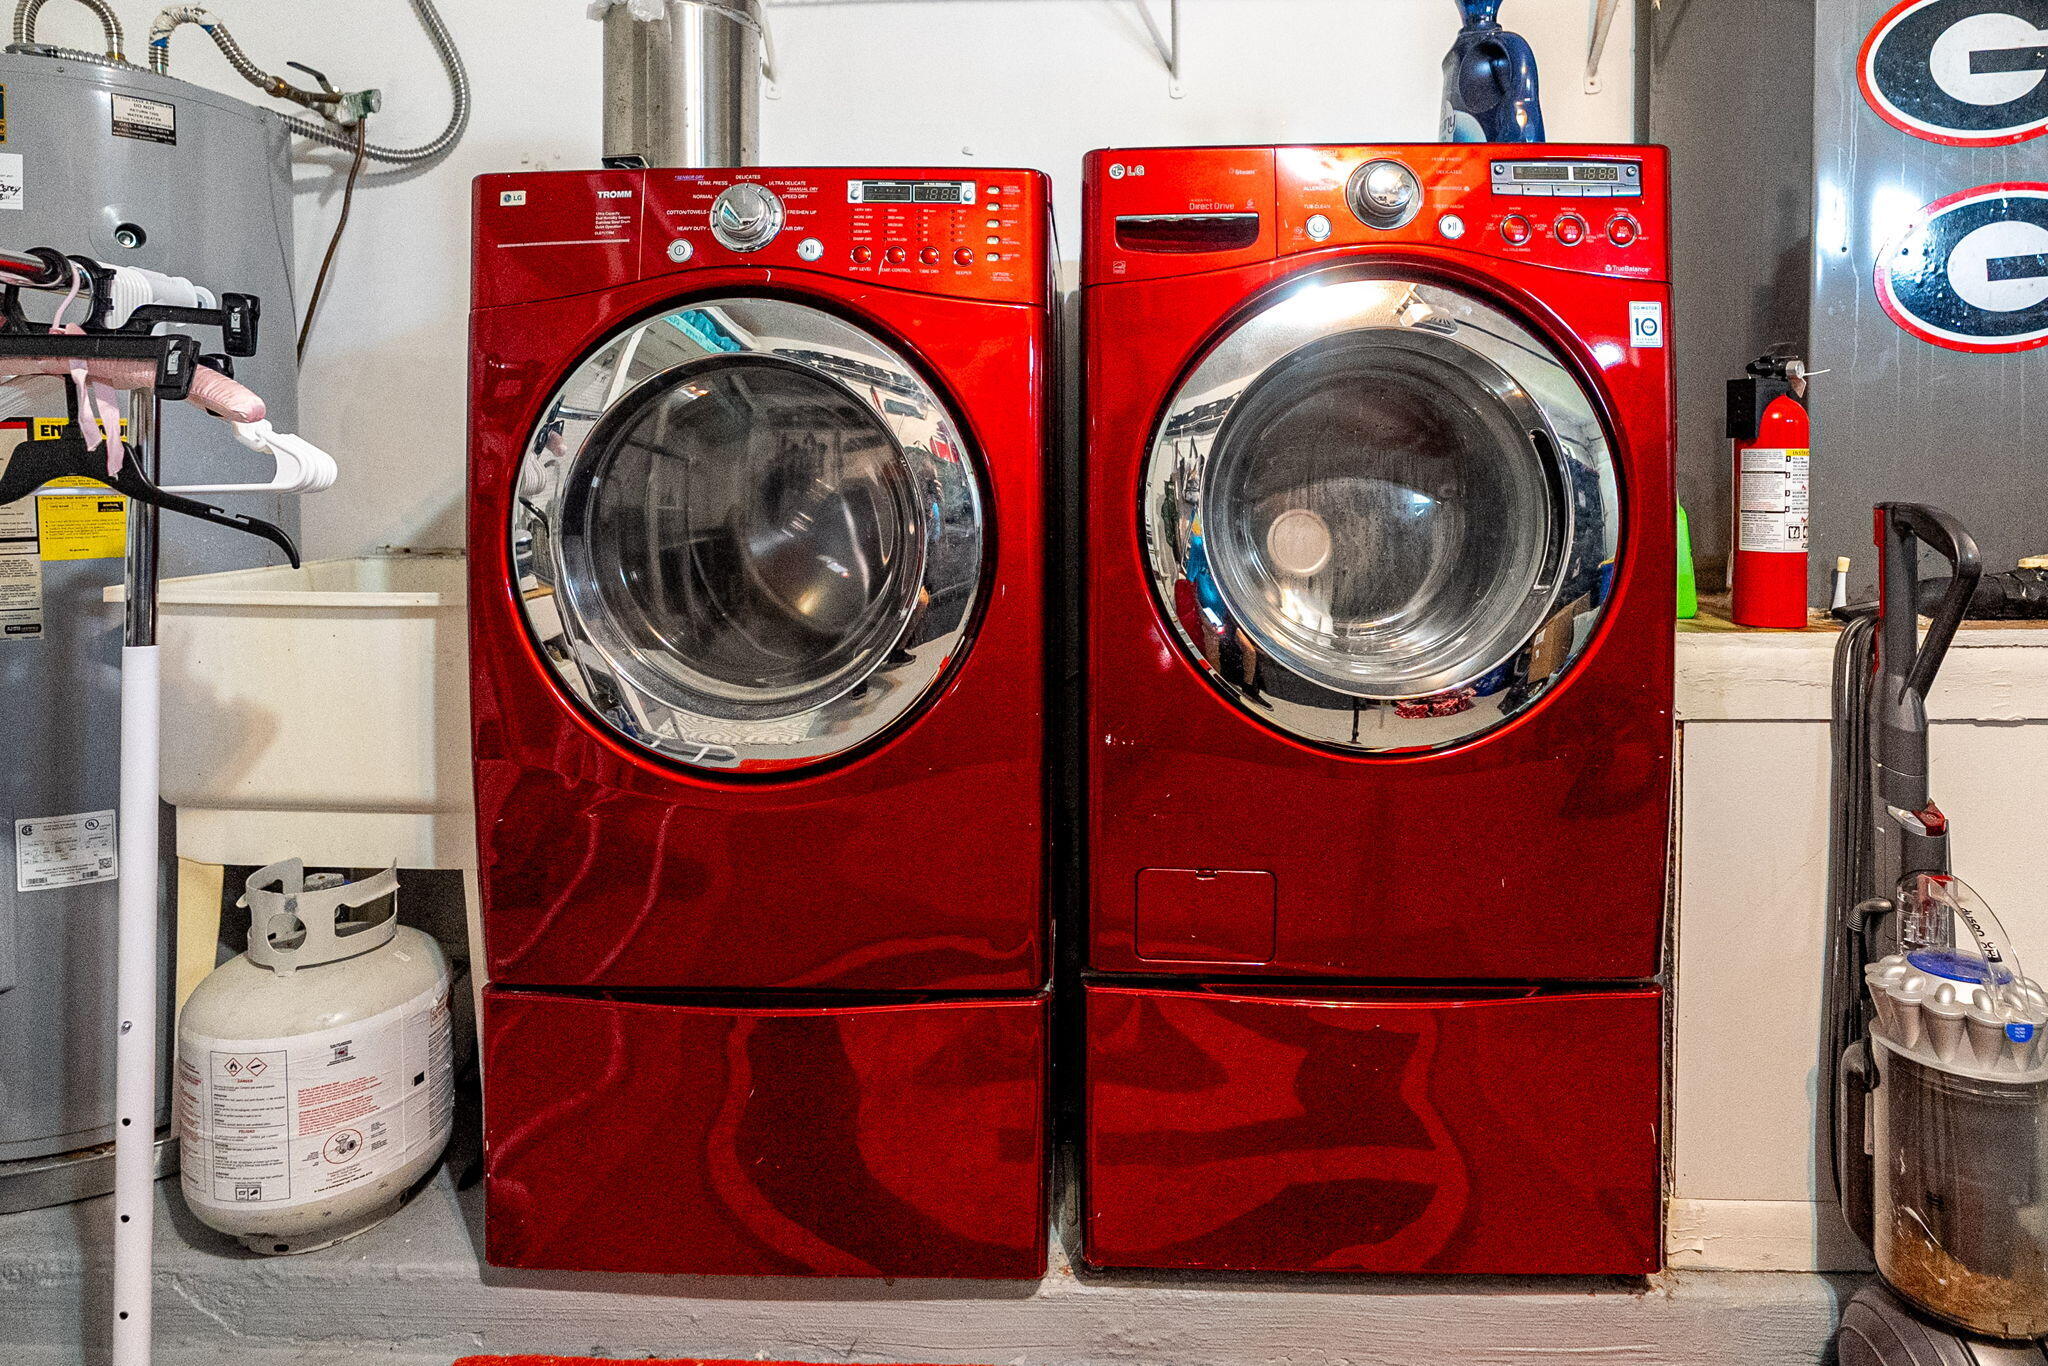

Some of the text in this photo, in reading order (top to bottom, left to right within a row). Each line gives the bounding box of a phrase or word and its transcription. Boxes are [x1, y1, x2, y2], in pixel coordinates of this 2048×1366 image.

[1930, 13, 2048, 105] G
[1612, 264, 1649, 272] TrueBalance
[1635, 318, 1657, 336] 10
[1961, 907, 1985, 937] dyson
